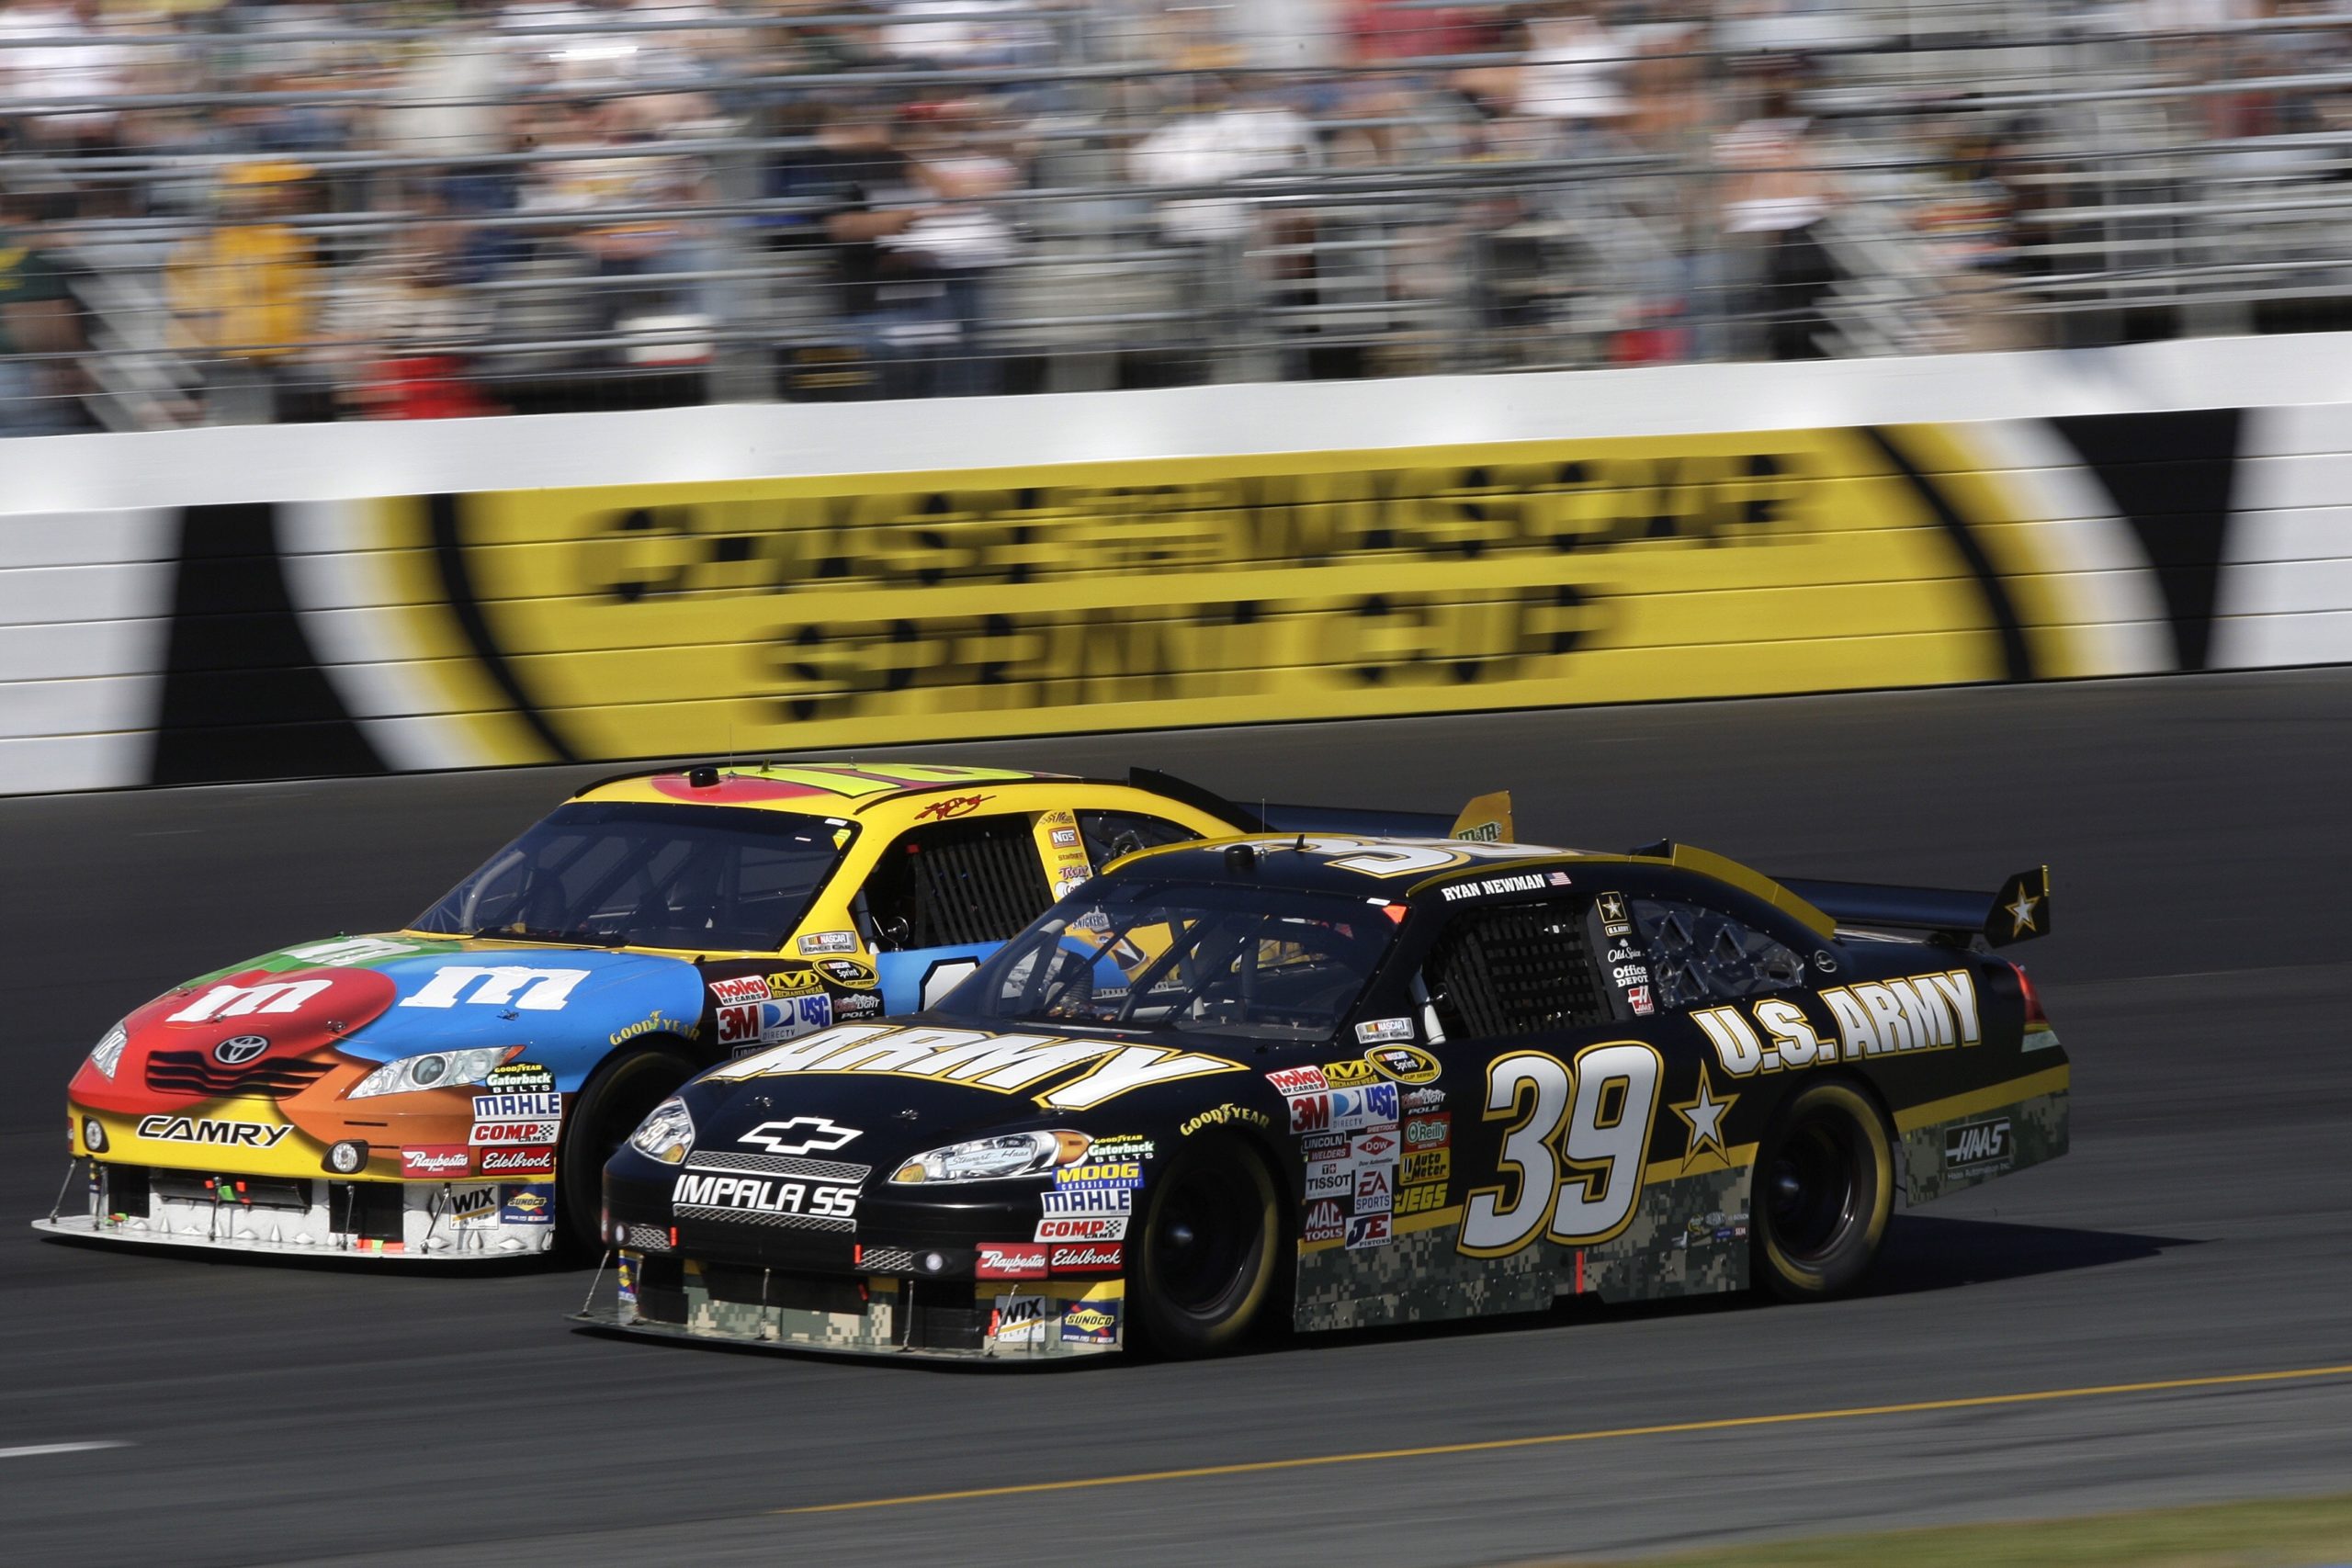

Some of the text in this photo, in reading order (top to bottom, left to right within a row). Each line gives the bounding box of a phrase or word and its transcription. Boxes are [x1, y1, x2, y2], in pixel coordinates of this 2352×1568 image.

[1052, 829, 1075, 842] NOS
[1442, 873, 1545, 901] RYAN NEWMAN
[820, 935, 846, 943] NASCAR
[1608, 949, 1624, 963] Old
[837, 968, 859, 978] Sprint
[1613, 964, 1646, 978] Office
[711, 977, 769, 999] Holley
[1616, 975, 1648, 987] DEPOT
[735, 993, 762, 1002] CARBS
[801, 996, 829, 1027] USG
[719, 1006, 759, 1041] 3M
[1378, 1021, 1404, 1031] NASCAR
[1689, 969, 1981, 1078] U.S. ARMY
[763, 1029, 795, 1039] DIRECTV
[692, 1023, 1251, 1111] ARMY
[1394, 1059, 1418, 1071] Sprint
[487, 1073, 551, 1087] Gatorback
[1269, 1069, 1327, 1089] Holley
[492, 1085, 550, 1093] BELTS
[1295, 1084, 1319, 1092] CARBS
[475, 1094, 560, 1116] MAHLE
[1365, 1086, 1397, 1121] USG
[1408, 1105, 1440, 1115] POLE
[1292, 1096, 1329, 1132] 3M
[137, 1115, 294, 1147] CAMRY
[1333, 1118, 1363, 1128] DIRECTV
[475, 1124, 538, 1141] COMP
[1407, 1121, 1448, 1143] O'Reilly
[1088, 1142, 1153, 1156] Gatorback
[1304, 1135, 1342, 1148] LINCOLN
[1455, 1041, 1665, 1258] 39
[1945, 1122, 2011, 1162] HAAS
[482, 1152, 551, 1169] Edelbrock
[1094, 1152, 1154, 1163] BELTS
[1312, 1148, 1346, 1159] WELDERS
[1414, 1153, 1442, 1165] Auto
[1057, 1162, 1139, 1183] MOOG
[1061, 1179, 1141, 1190] CHASSIS PARTS
[1307, 1175, 1351, 1190] TISSOT
[1359, 1170, 1389, 1197] EA
[452, 1187, 495, 1213] WIX
[508, 1197, 547, 1206] SUNOCO
[672, 1174, 862, 1216] IMPALA SS
[1046, 1190, 1129, 1212] MAHLE
[1356, 1195, 1390, 1210] SPORTS
[1394, 1183, 1448, 1213] JEGS
[1306, 1201, 1342, 1229] MAC
[1040, 1220, 1105, 1237] COMP
[1306, 1227, 1343, 1240] TOOLS
[1347, 1214, 1389, 1247] JE
[1051, 1248, 1121, 1266] Edelbrock
[1067, 1314, 1113, 1325] SUNOCO
